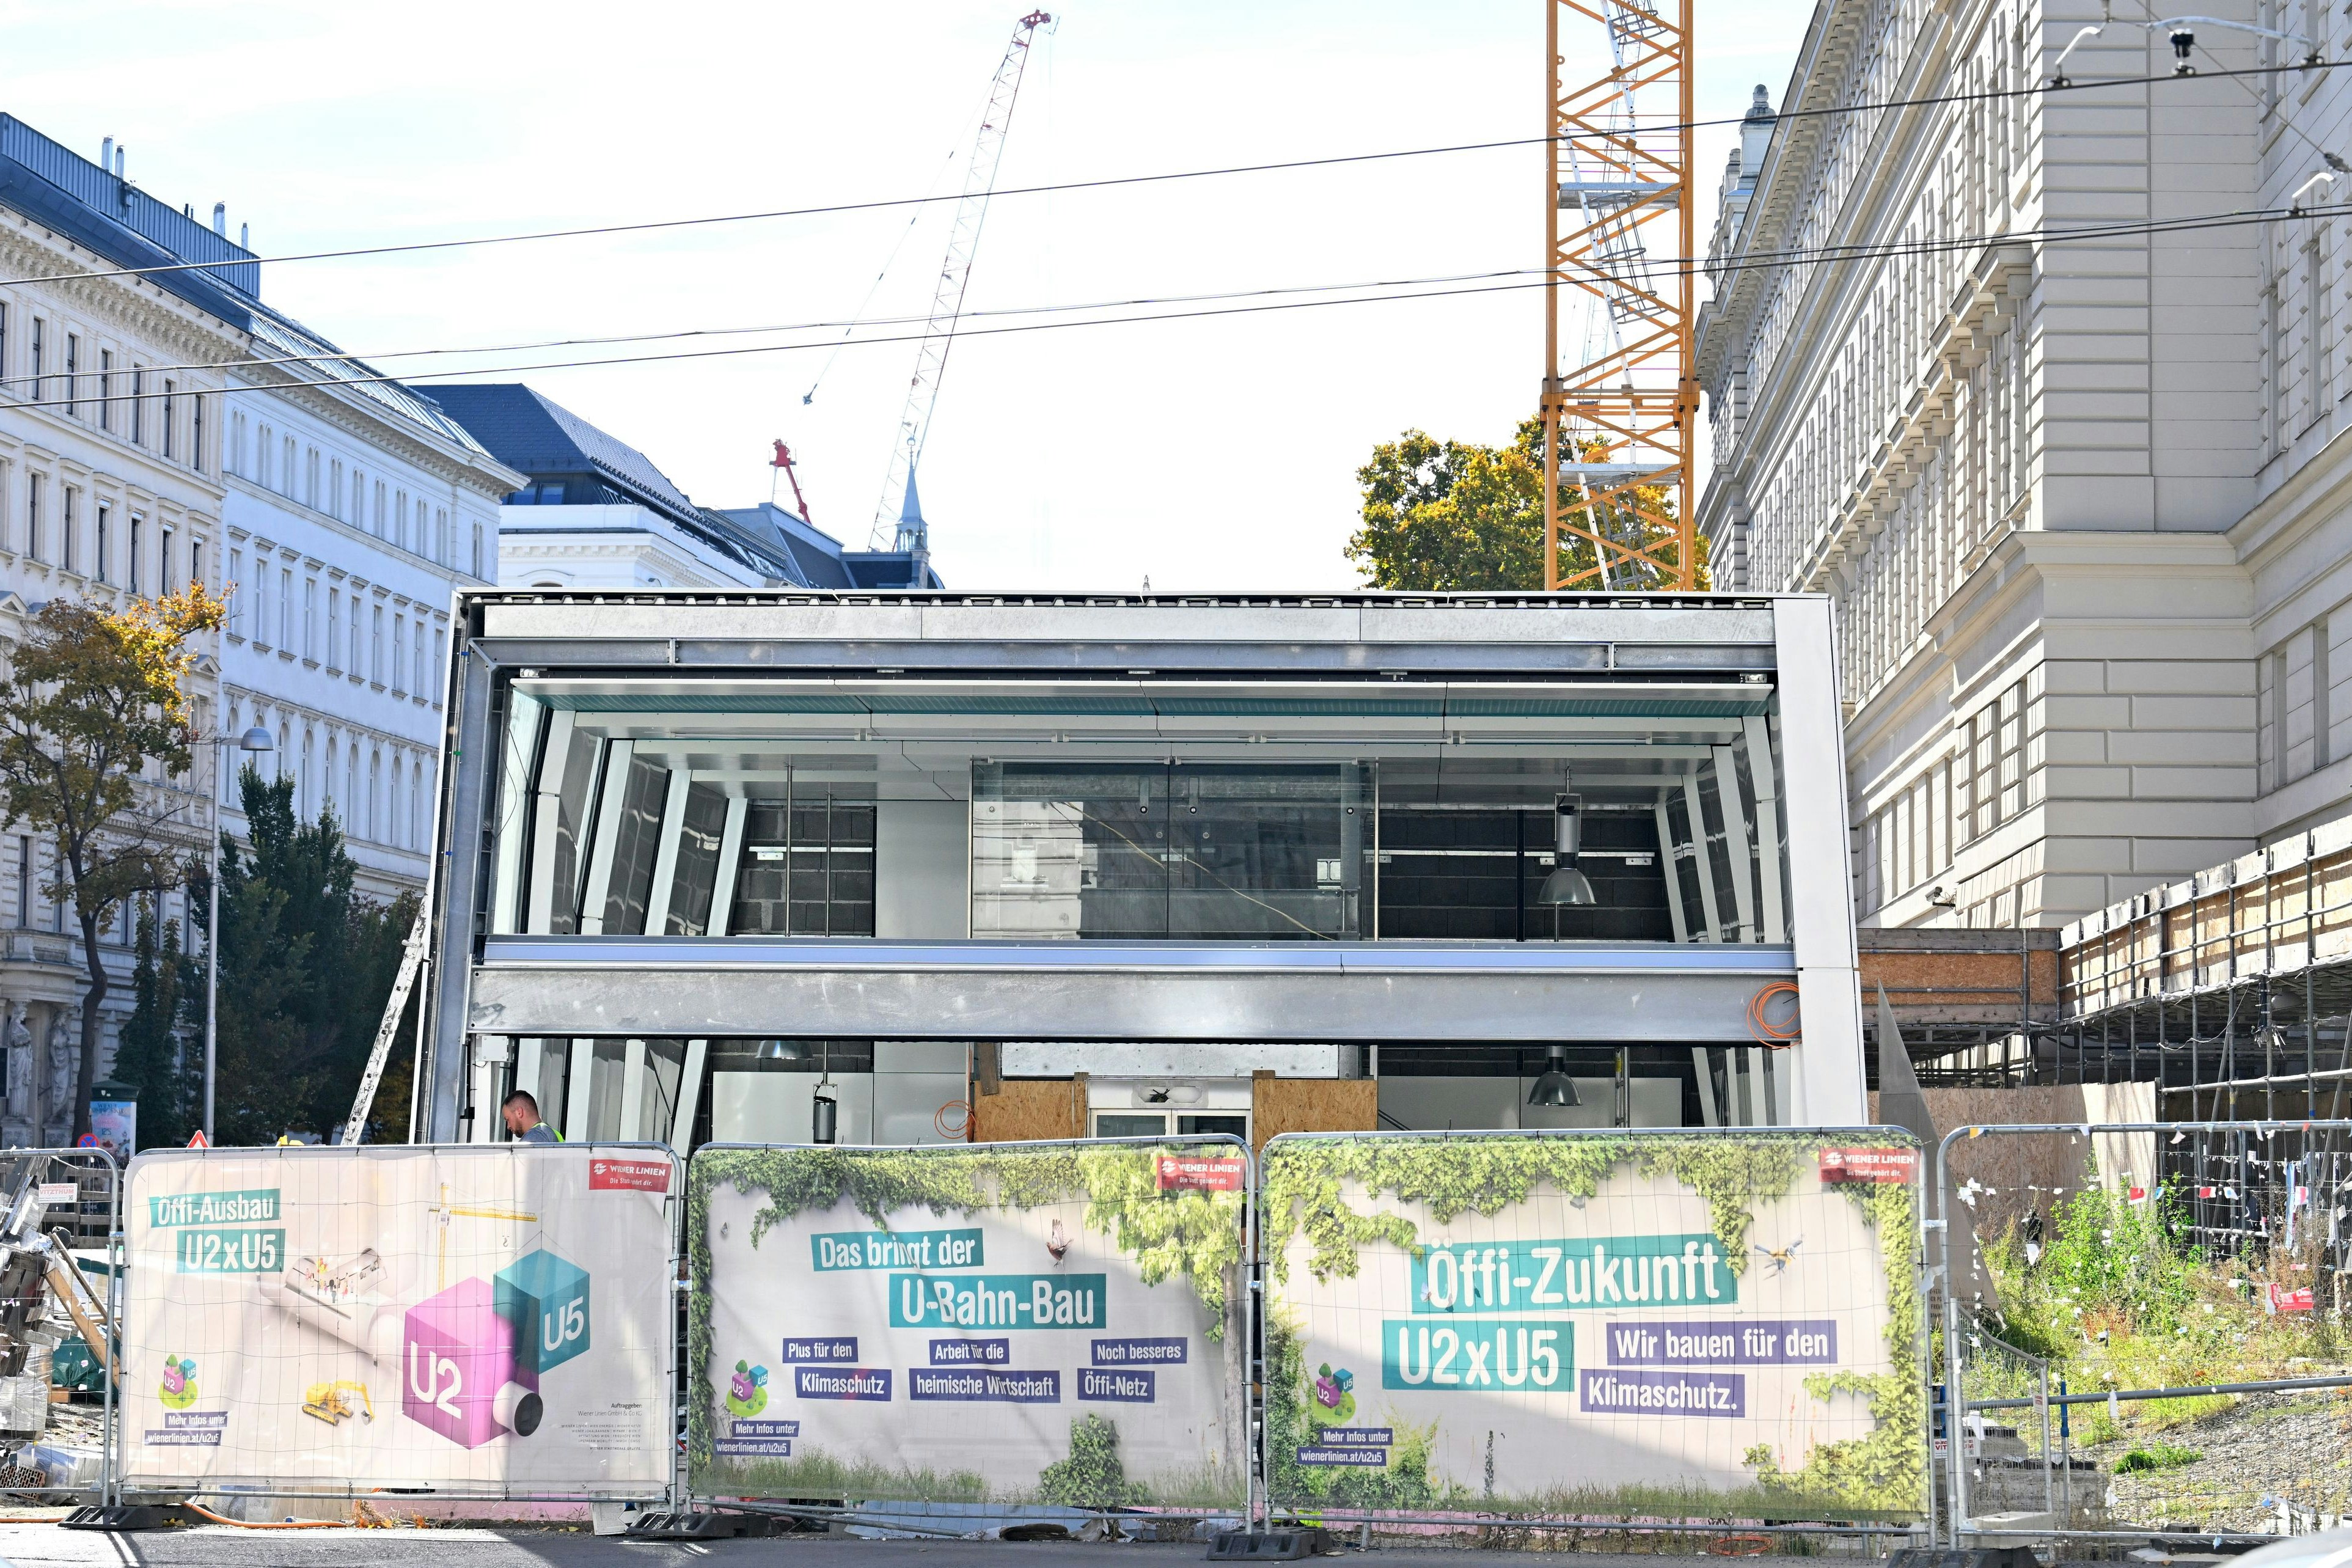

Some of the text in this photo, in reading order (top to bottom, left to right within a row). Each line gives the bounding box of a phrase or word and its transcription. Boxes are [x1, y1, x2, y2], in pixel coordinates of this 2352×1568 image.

[1844, 1154, 1914, 1164] WIENER LINIEN
[610, 1165, 666, 1176] WIENER LINIEN
[1178, 1163, 1240, 1173] WIENER LINIEN
[158, 1194, 273, 1225] Öffi-Ausbau
[185, 1234, 276, 1269] U2xU5
[819, 1233, 975, 1272] Das bringt der
[1427, 1237, 1720, 1308] Öffi-Zukunft
[902, 1278, 1094, 1325] U-Bahn-Bau
[544, 1295, 584, 1351] U5
[788, 1342, 852, 1358] Plus für den
[1615, 1328, 1828, 1358] Wir bauen für den
[935, 1343, 1004, 1360] Arbeit für die
[1097, 1344, 1181, 1360] Noch besseres
[1399, 1326, 1559, 1386] U2xU5
[188, 1368, 196, 1377] U5
[410, 1340, 461, 1420] U2
[758, 1374, 768, 1385] U5
[164, 1375, 175, 1390] U2
[732, 1381, 744, 1397] U2
[802, 1372, 885, 1394] Klimaschutz
[917, 1374, 1054, 1396] heimische Wirtschaft
[1085, 1371, 1148, 1396] Öffi-Netz
[1343, 1378, 1353, 1390] U5
[1317, 1386, 1330, 1403] U2
[1589, 1376, 1737, 1410] Klimaschutz.
[169, 1415, 225, 1425] Mehr Infos unter
[736, 1423, 796, 1434] Mehr Infos unter
[1324, 1431, 1389, 1442] Mehr Infos unter
[148, 1433, 219, 1443] wienerlinien.at/u2u5
[716, 1442, 786, 1453] wienerlinien.at/u2u5
[1301, 1450, 1382, 1462] wienerlinien.at/u2u5
